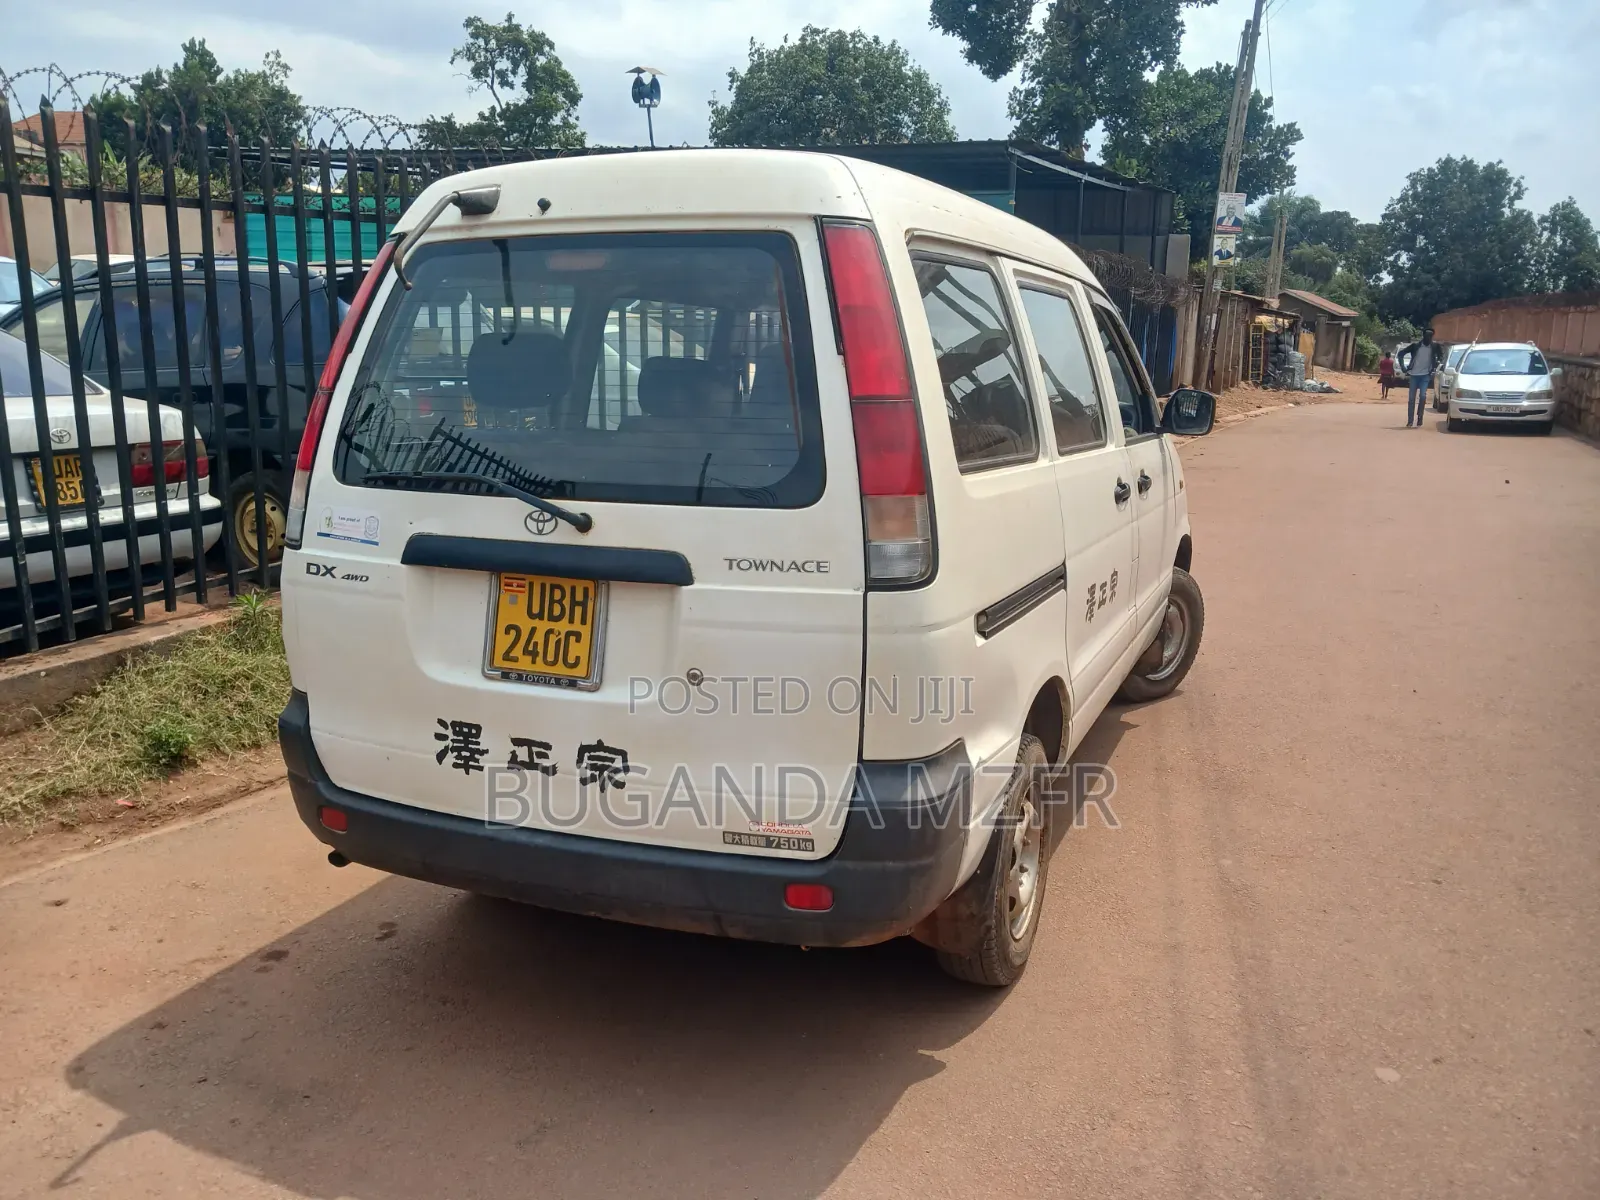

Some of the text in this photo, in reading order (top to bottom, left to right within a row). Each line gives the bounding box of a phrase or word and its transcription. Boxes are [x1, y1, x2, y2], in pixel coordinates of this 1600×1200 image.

[305, 562, 370, 583] DX 4WD
[723, 557, 830, 574] TOWNACE
[526, 581, 590, 626] UBH
[502, 623, 582, 670] 240C
[522, 673, 556, 685] TOYOTA
